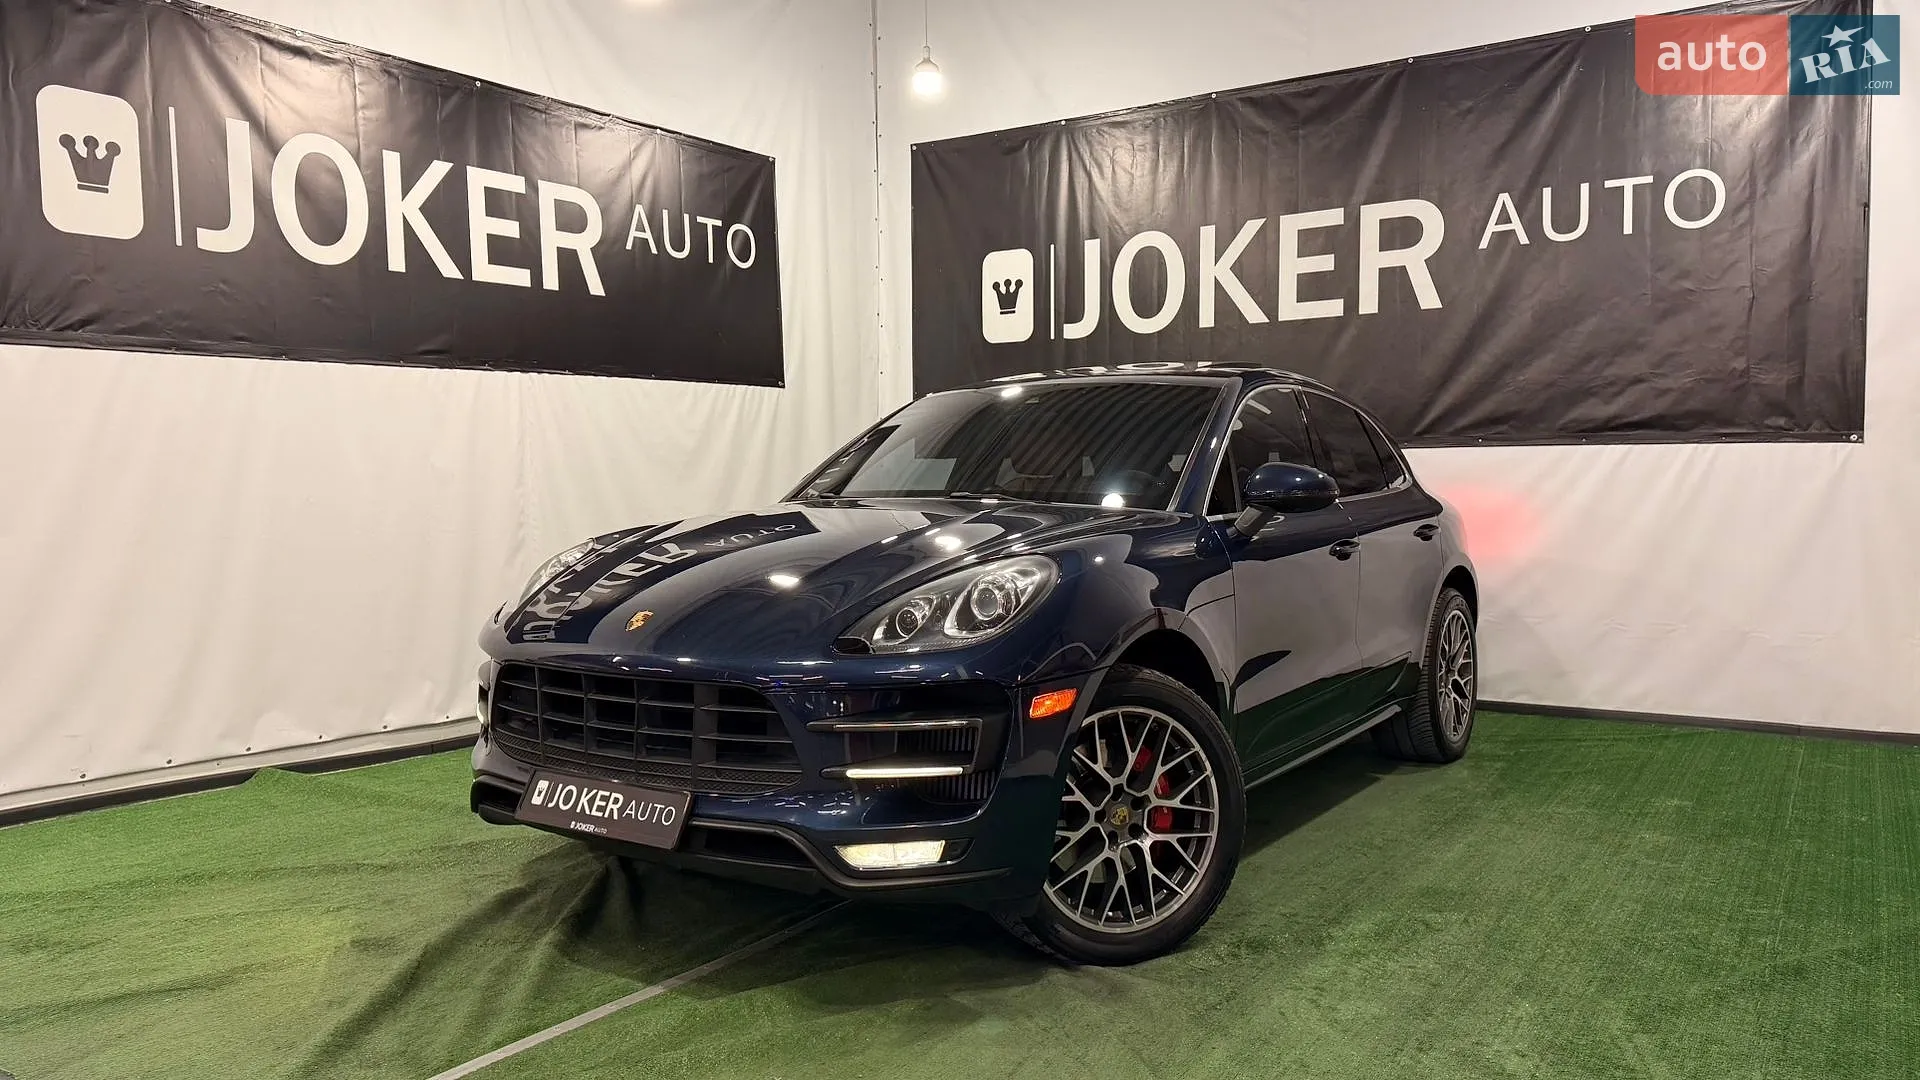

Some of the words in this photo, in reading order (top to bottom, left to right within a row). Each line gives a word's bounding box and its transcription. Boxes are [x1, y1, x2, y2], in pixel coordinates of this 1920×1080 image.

[196, 117, 606, 297] JOKER
[625, 203, 757, 270] AUTO
[1063, 198, 1446, 340] JOKER
[1478, 168, 1727, 250] AUTO
[547, 783, 624, 820] JOKER
[622, 799, 676, 826] AUTO
[575, 822, 595, 833] JOKER
